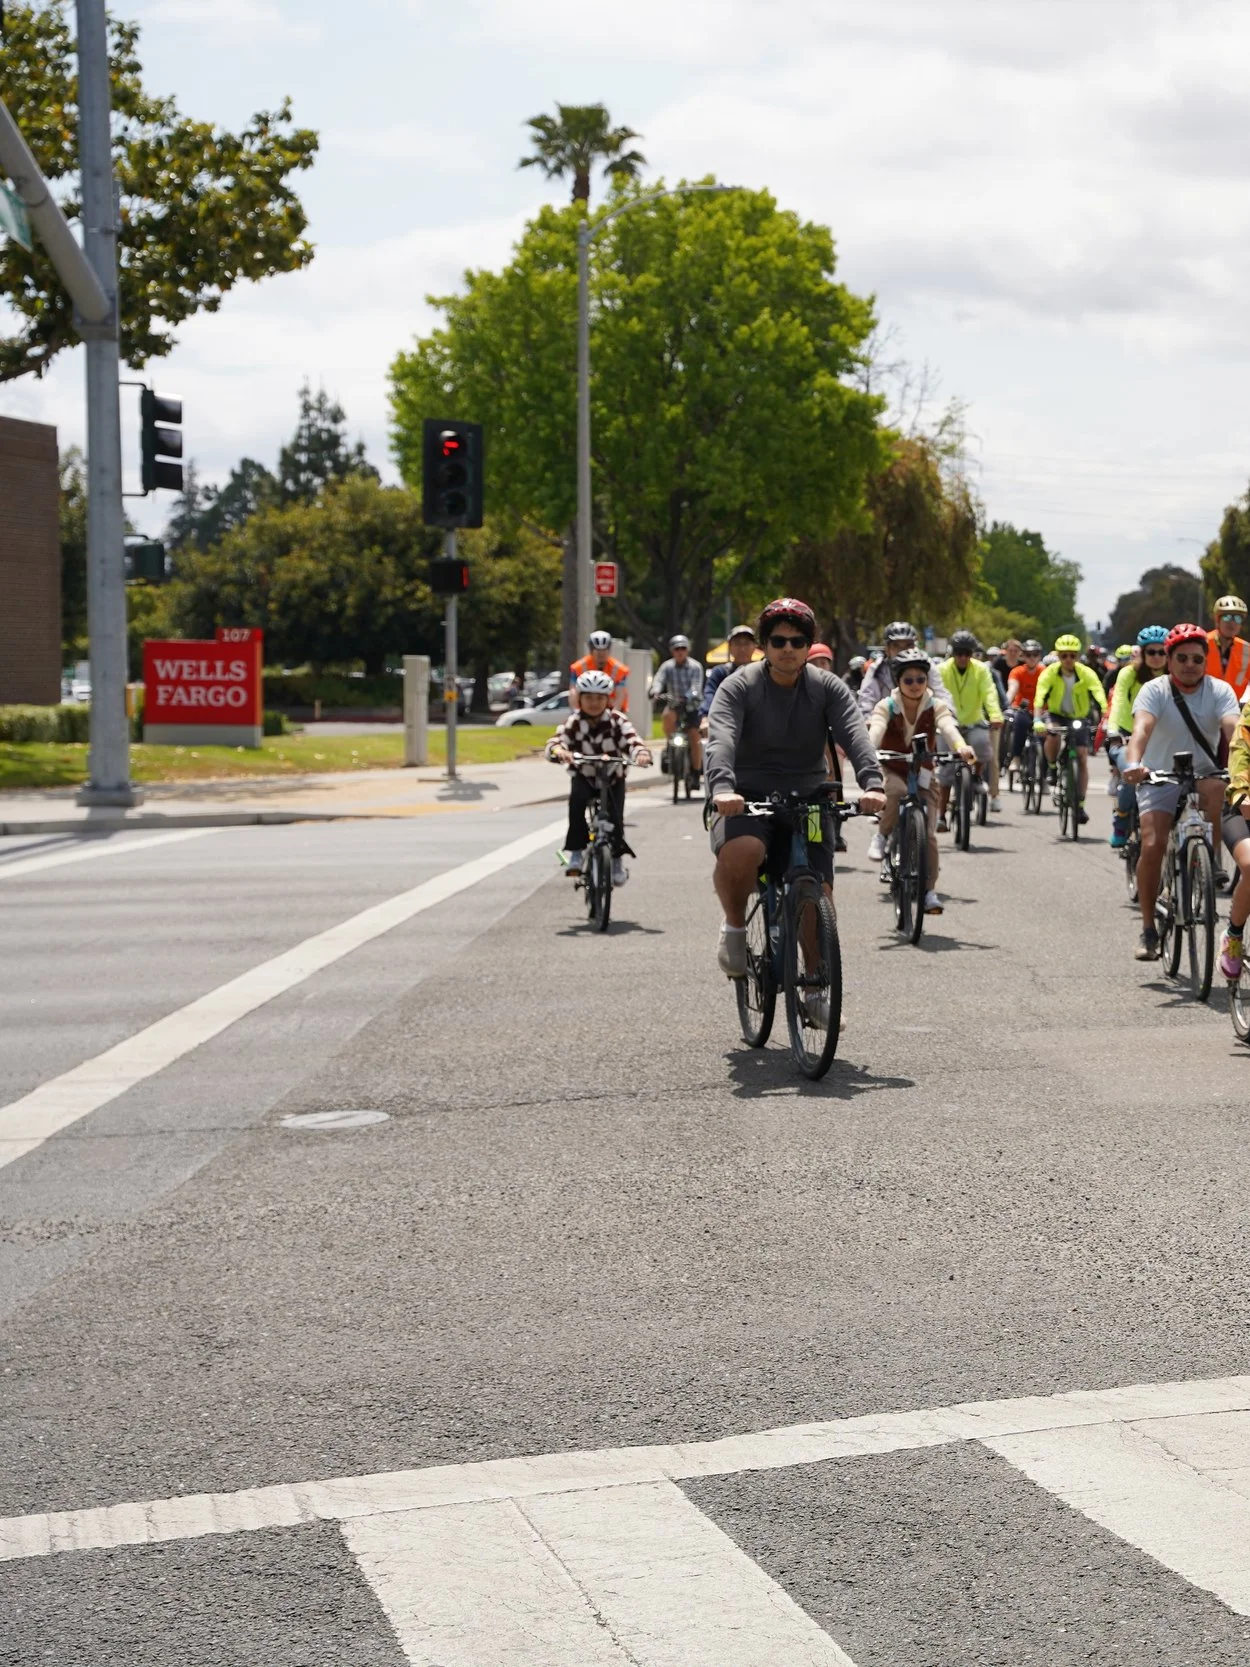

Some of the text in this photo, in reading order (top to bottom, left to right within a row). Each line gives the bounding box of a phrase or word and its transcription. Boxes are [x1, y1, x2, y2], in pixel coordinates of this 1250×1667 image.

[222, 628, 251, 642] 107
[153, 659, 248, 681] WELLS
[156, 685, 248, 707] FARGO
